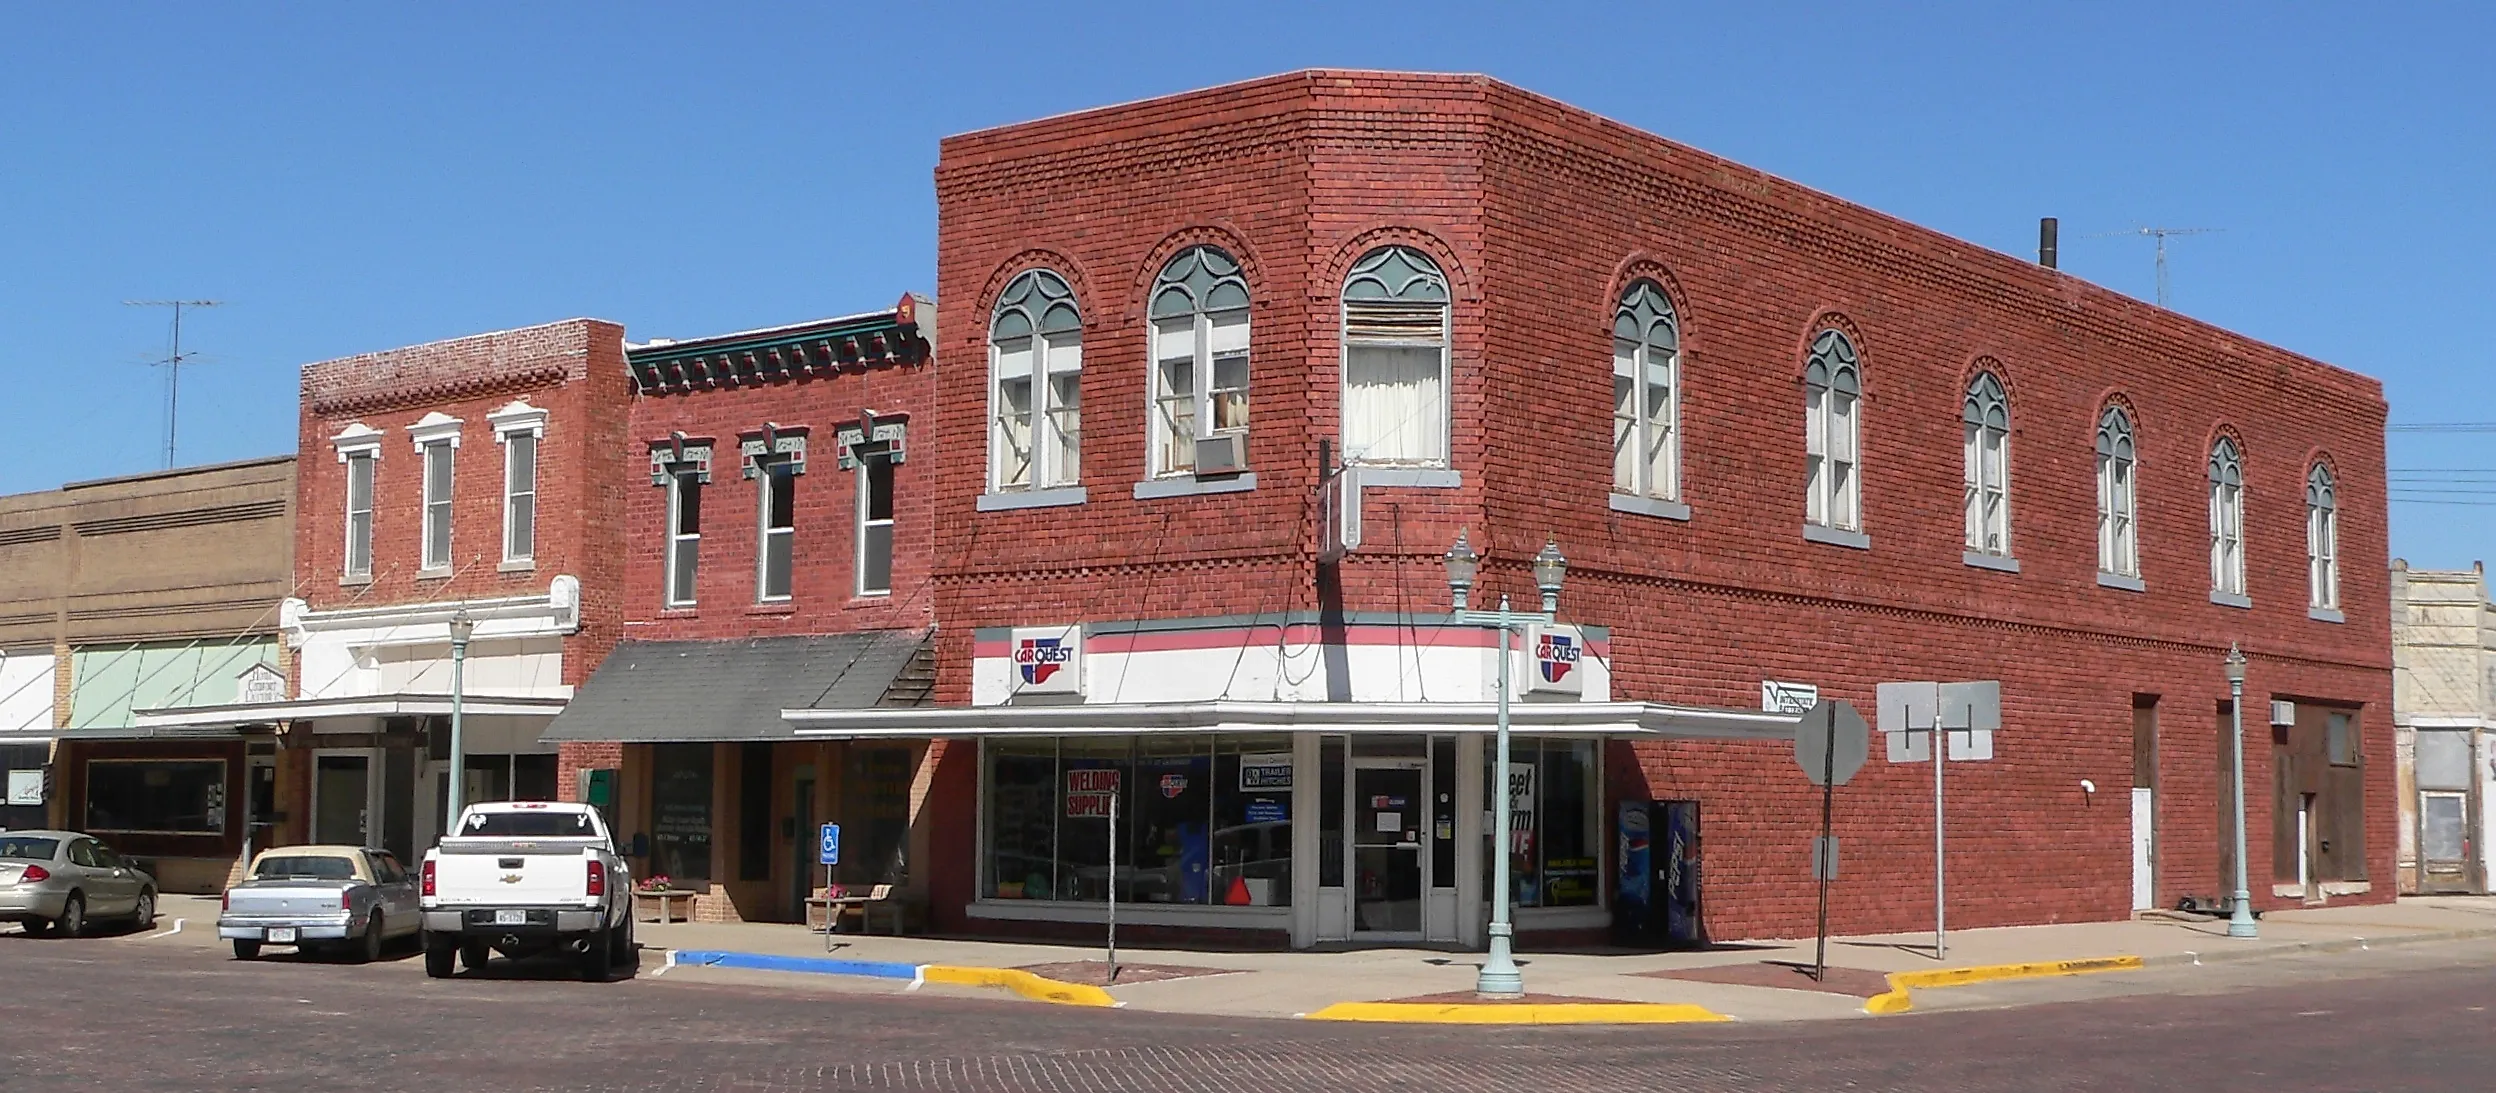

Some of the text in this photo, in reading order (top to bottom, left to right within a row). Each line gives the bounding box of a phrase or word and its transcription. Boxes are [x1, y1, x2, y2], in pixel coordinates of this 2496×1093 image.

[1015, 647, 1074, 664] CARQUEST
[1536, 644, 1581, 662] CARQUEST
[1069, 771, 1120, 792] WELDING
[1668, 830, 1685, 900] PEPSI
